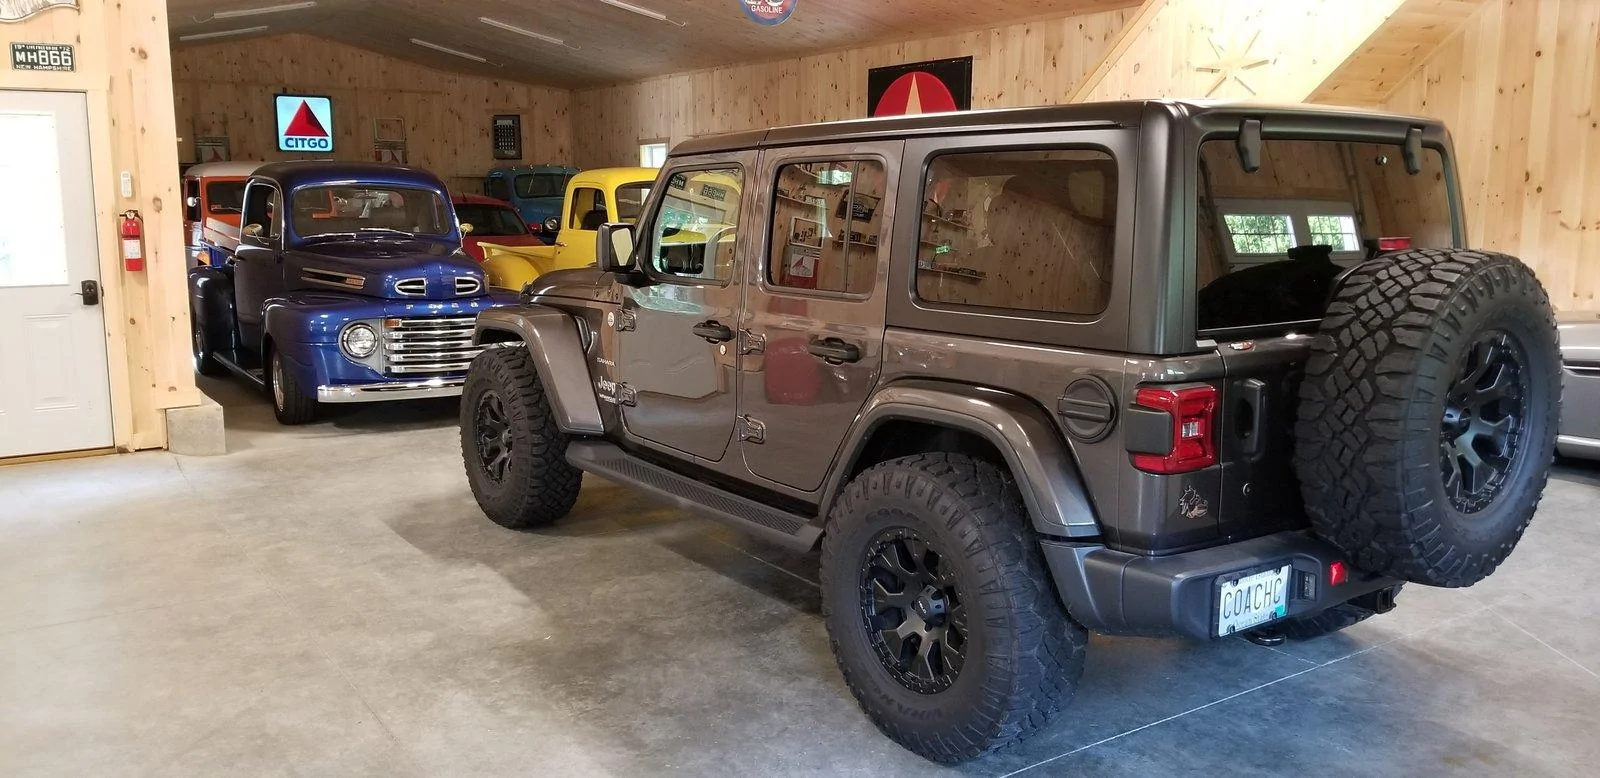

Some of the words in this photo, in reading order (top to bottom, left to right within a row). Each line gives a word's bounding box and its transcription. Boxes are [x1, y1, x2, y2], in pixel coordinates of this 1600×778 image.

[751, 5, 783, 13] GASOLINE
[15, 50, 72, 66] MH866
[284, 137, 329, 149] CITGO
[598, 375, 616, 395] Jeep
[1223, 577, 1282, 619] COACHC
